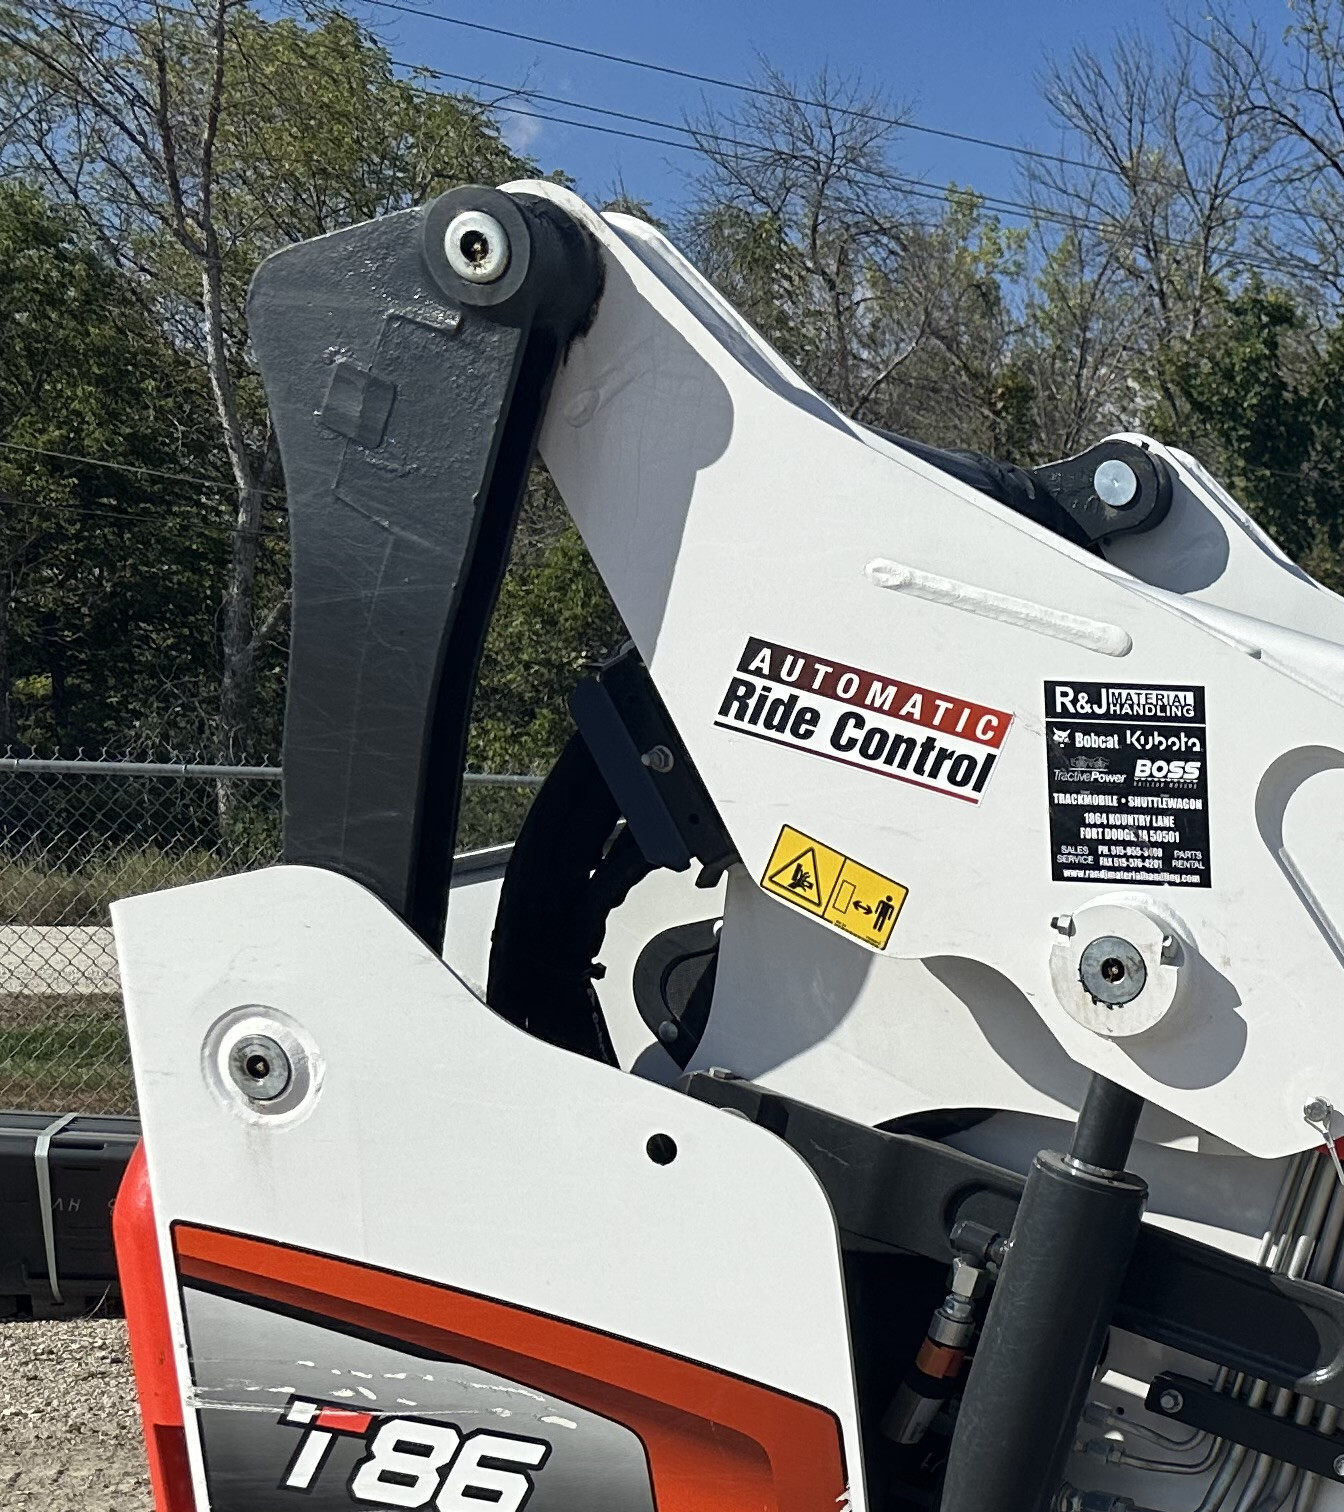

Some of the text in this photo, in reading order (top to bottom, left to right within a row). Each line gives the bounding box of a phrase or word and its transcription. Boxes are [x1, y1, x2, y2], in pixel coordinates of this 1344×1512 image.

[748, 647, 1000, 741] AUTOMATIC
[1055, 686, 1108, 714] R&J
[1110, 691, 1192, 706] MATERIAL
[1109, 703, 1195, 717] HANDLING
[717, 676, 997, 793] Ride Control
[1074, 732, 1119, 749] Bobcat
[1126, 729, 1201, 752] Kubota
[1134, 759, 1201, 779] BOSS
[1052, 793, 1202, 810] TRACKMOBILE SHUTTLEWAGON
[1152, 815, 1175, 828] LANE
[1080, 827, 1103, 839] FORT
[1149, 830, 1180, 843] 50501
[1060, 845, 1089, 855] SALES
[1173, 850, 1202, 860] PARTS
[1056, 854, 1094, 864] SERVICE
